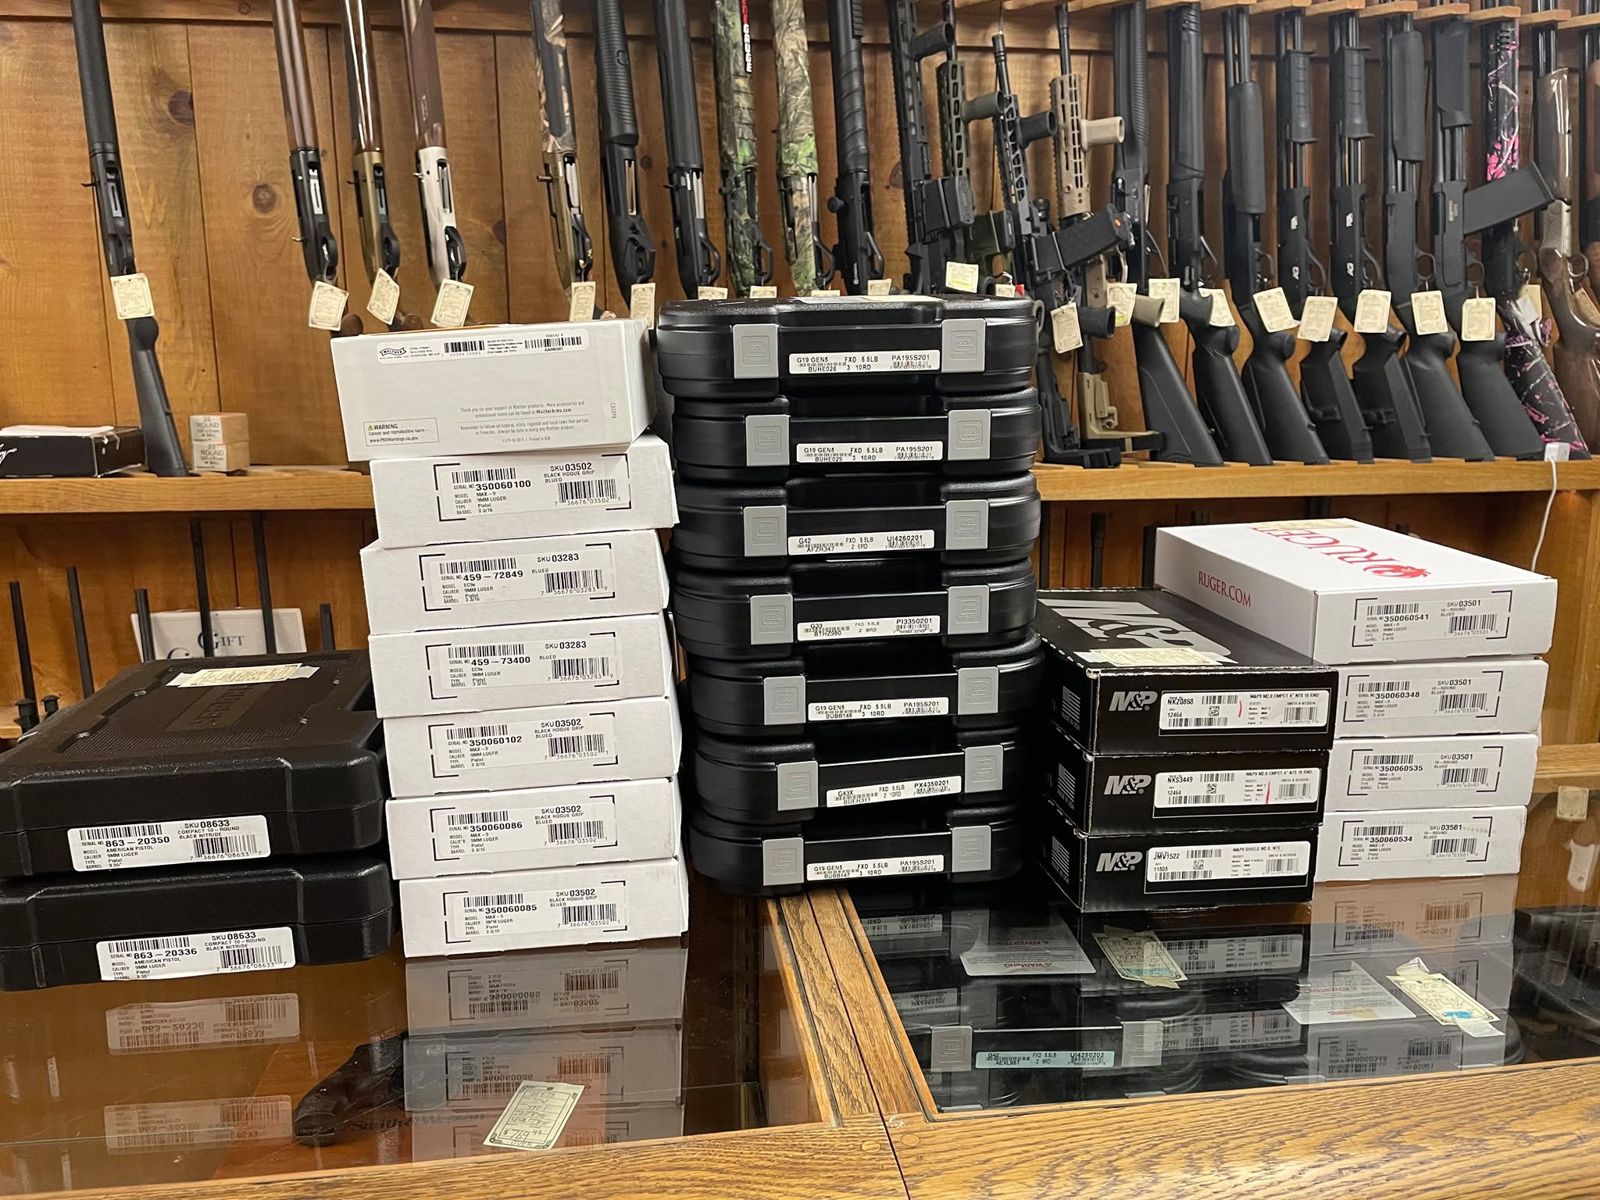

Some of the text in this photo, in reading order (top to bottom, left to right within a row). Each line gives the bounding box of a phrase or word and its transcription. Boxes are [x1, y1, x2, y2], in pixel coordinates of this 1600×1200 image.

[565, 462, 592, 471] 03502
[475, 479, 531, 491] 350060100
[552, 553, 579, 562] 03283
[1198, 571, 1251, 607] RUGER.COM
[1384, 614, 1429, 622] 350060541
[559, 641, 587, 649] 03283
[1109, 691, 1158, 712] M&P
[555, 718, 582, 727] 03502
[469, 736, 523, 747] 350060102
[914, 780, 949, 788] PX4350201
[1104, 775, 1151, 795] M&P
[555, 806, 581, 814] 03502
[200, 820, 230, 828] 08633
[470, 822, 523, 832] 350060086
[1096, 851, 1142, 872] M&P
[569, 888, 596, 896] 03502
[485, 904, 537, 915] 350060085
[227, 932, 257, 940] 08633
